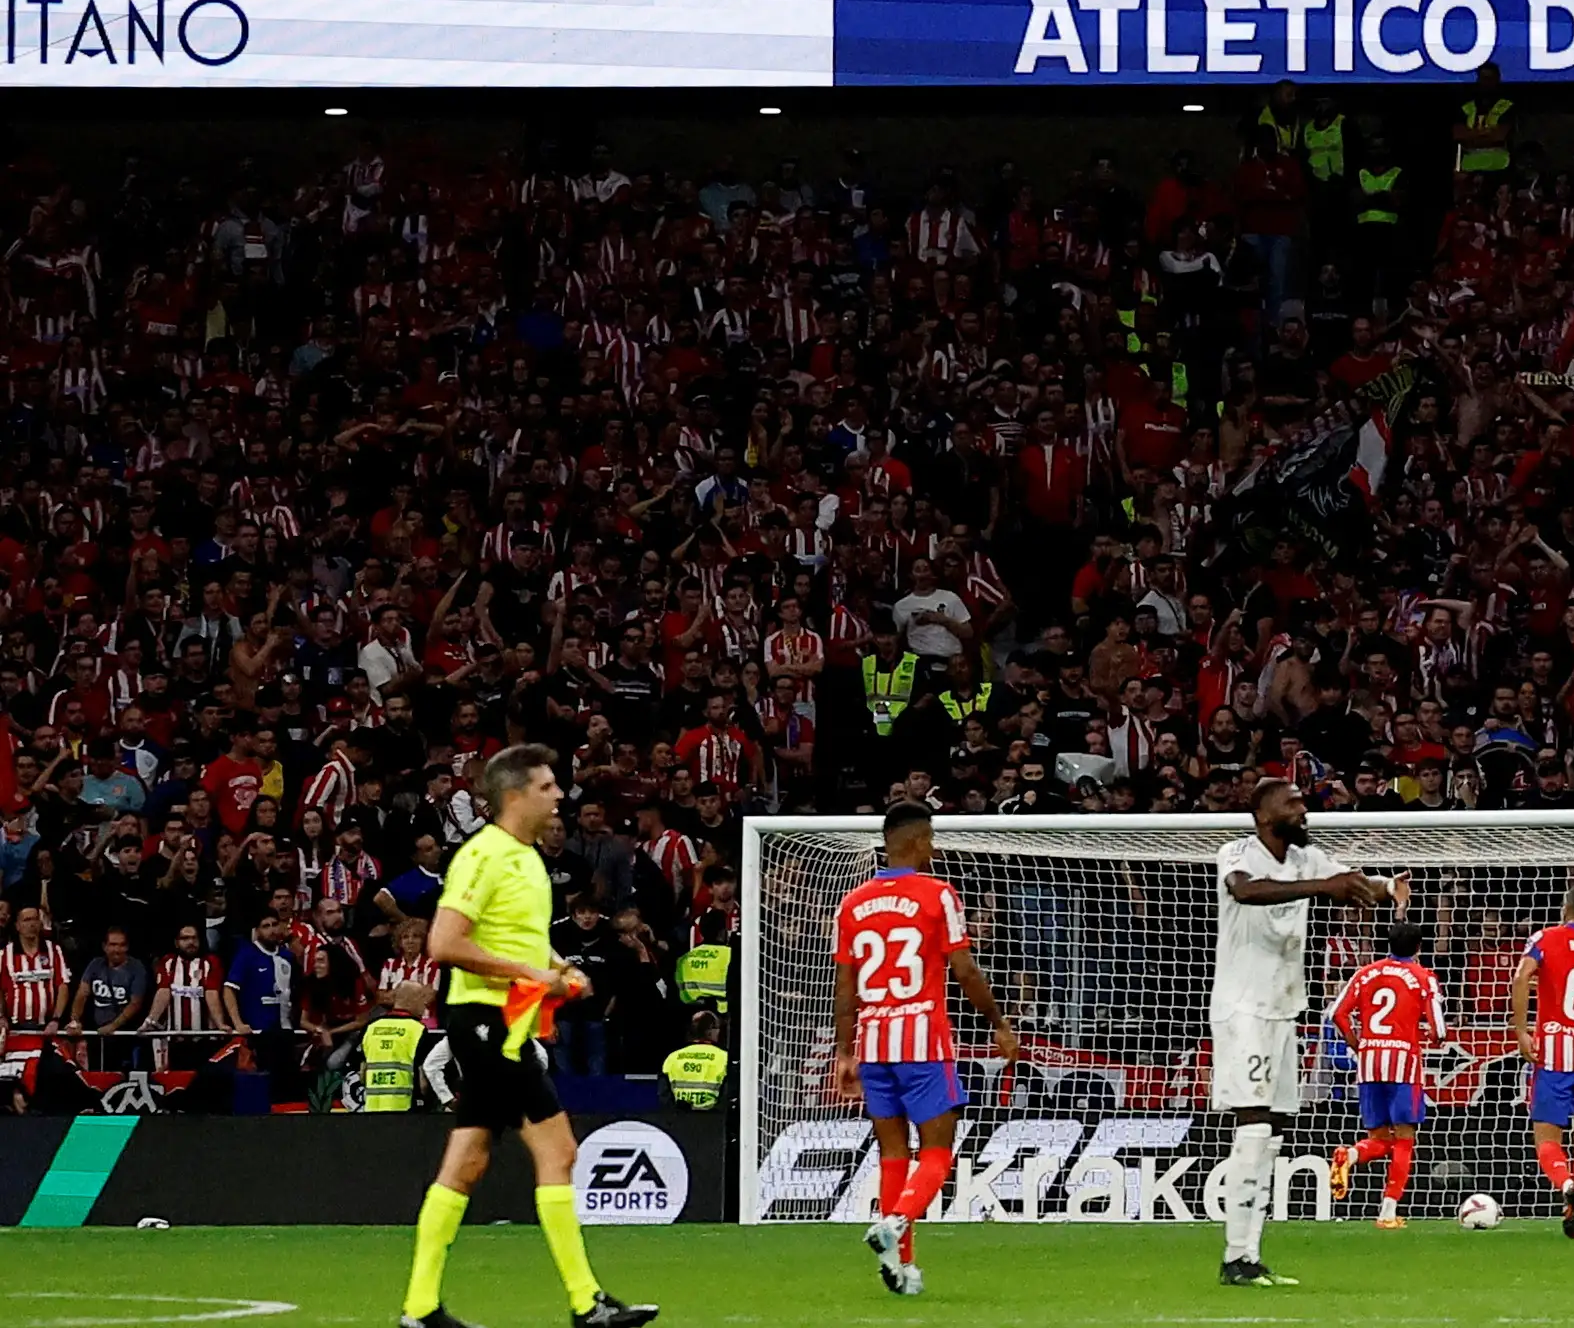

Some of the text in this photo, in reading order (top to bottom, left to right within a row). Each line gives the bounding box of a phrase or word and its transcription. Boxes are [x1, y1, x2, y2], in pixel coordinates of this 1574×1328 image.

[852, 926, 924, 1002] 23
[1369, 988, 1397, 1035] 2
[588, 1148, 667, 1190] EA
[586, 1191, 668, 1210] SPORTS
